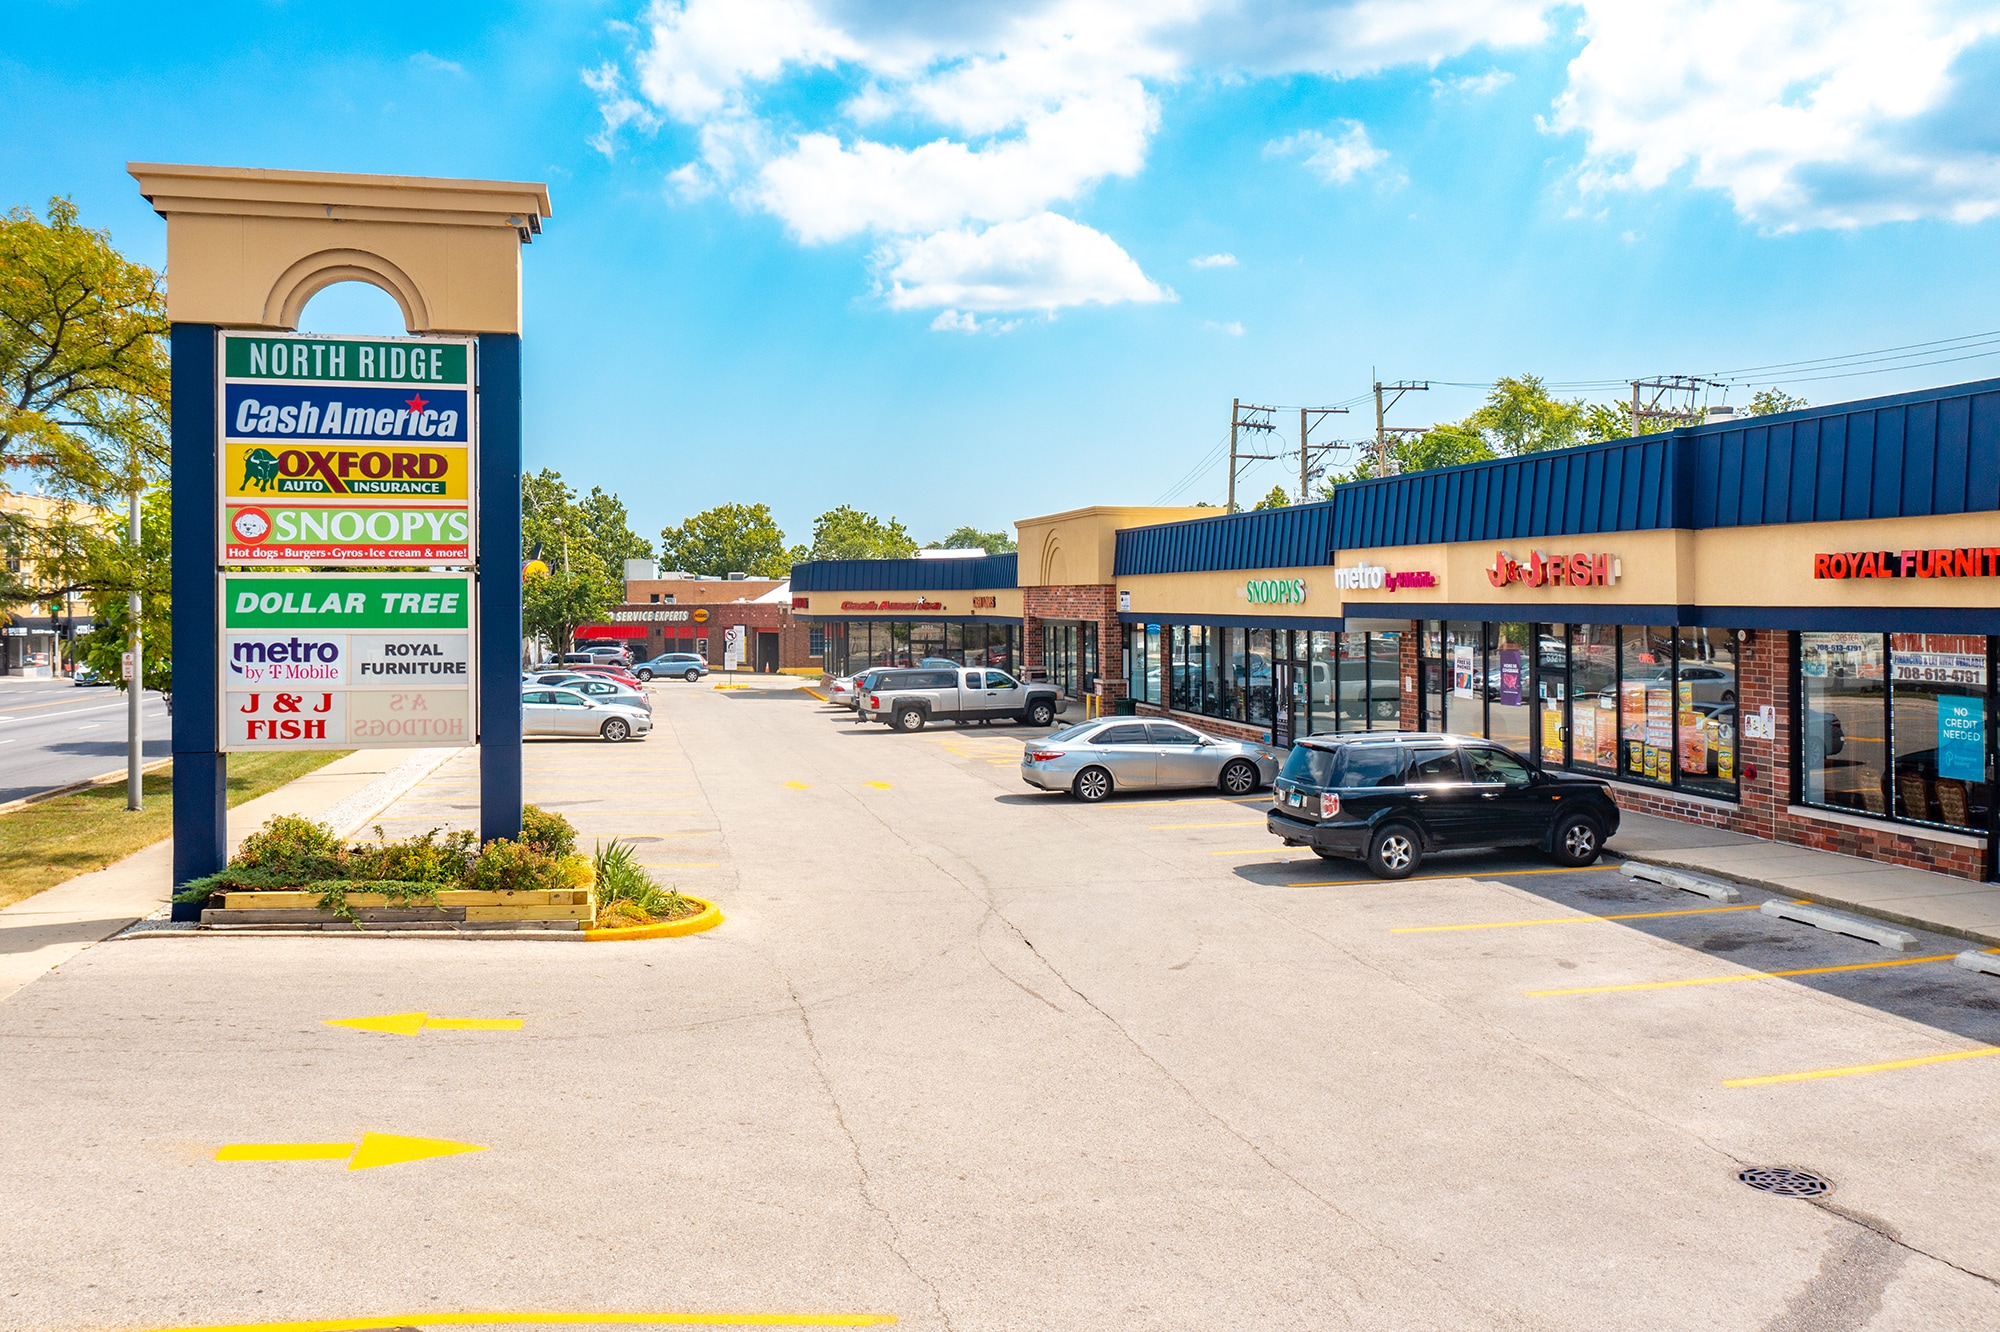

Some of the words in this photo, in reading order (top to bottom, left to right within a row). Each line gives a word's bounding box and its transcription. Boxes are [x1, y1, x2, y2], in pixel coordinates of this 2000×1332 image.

[250, 342, 345, 377] NORTH
[359, 346, 443, 379] RIDGE
[277, 450, 448, 493] OXFORD
[283, 480, 323, 491] AUTO
[354, 481, 439, 493] INSURANCE
[276, 511, 468, 541] SNOOPYS
[229, 548, 250, 557] Hot
[253, 548, 278, 560] dogs
[285, 548, 326, 560] Burgers
[332, 548, 363, 560] Gyros
[369, 548, 385, 557] Ice
[388, 549, 421, 557] cream
[424, 548, 433, 557] &
[436, 548, 467, 557] more!
[1814, 551, 1893, 579] ROYAL
[1901, 548, 2000, 579] FURNIT
[1334, 562, 1385, 589] metro
[1486, 550, 1508, 588] J
[1508, 560, 1517, 581] &
[1520, 549, 1543, 588] J
[1548, 553, 1609, 586] FISH
[1247, 579, 1302, 603] SNOOPYS
[235, 592, 366, 614] DOLLAR
[381, 593, 459, 614] TREE
[841, 601, 877, 610] Cash
[878, 600, 941, 611] America
[616, 611, 654, 621] SERVICE
[654, 611, 689, 621] EXPERTS
[233, 638, 339, 663] metro
[384, 644, 443, 656] ROYAL
[1892, 633, 1924, 652] ROYAL
[1925, 634, 1987, 655] FURNITURE
[361, 662, 466, 675] FURNITURE
[1894, 654, 1922, 665] FINANCING
[1923, 656, 1928, 666] &
[1928, 656, 1938, 666] LAY
[1955, 657, 1985, 669] AVAILABLE
[245, 665, 264, 683] by
[285, 664, 339, 679] Mobile
[1897, 667, 1980, 683] 708-613-4791
[240, 693, 259, 713] J
[273, 693, 303, 713] &
[313, 693, 333, 713] J
[1954, 707, 1968, 717] NO
[246, 720, 326, 740] FISH
[1945, 718, 1977, 729] CREDIT
[1943, 729, 1981, 742] NEEDED
